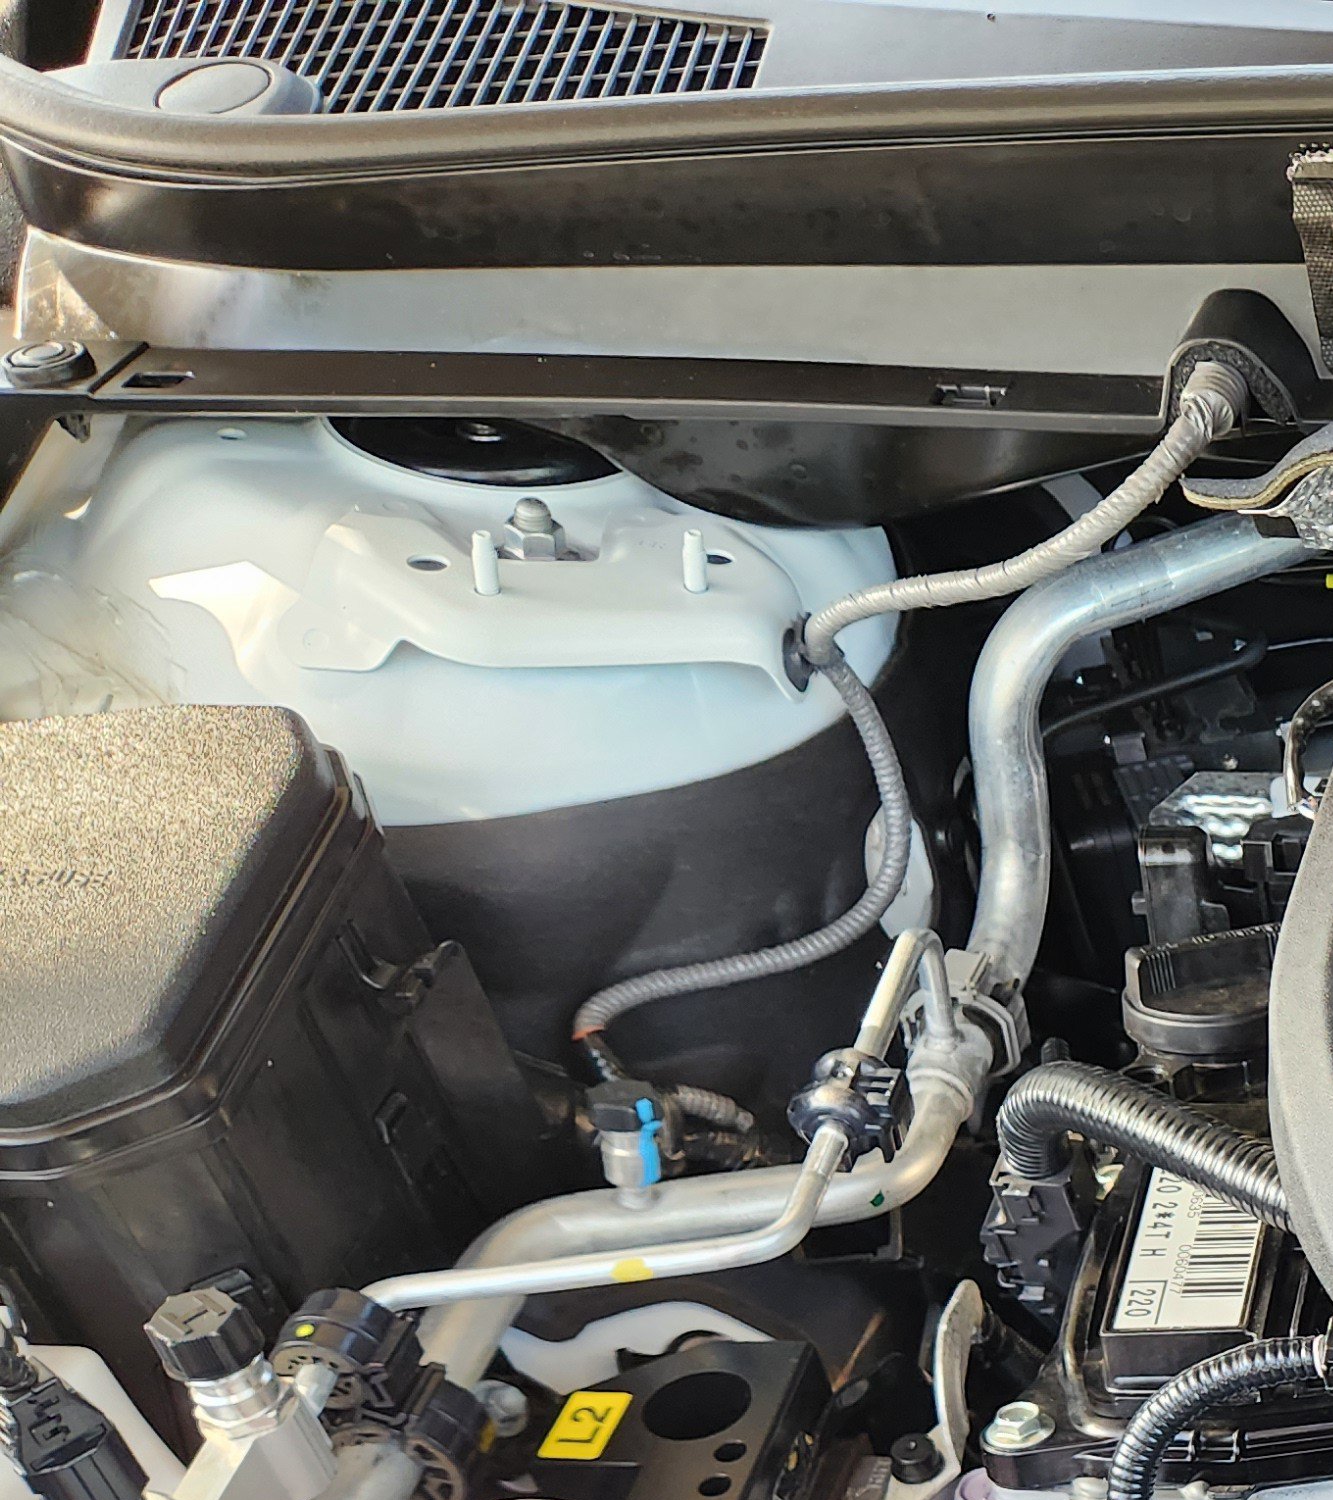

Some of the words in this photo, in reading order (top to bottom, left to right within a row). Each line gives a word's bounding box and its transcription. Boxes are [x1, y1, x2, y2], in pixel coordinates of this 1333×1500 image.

[1156, 1170, 1183, 1194] 20
[1124, 1288, 1157, 1318] 220
[556, 1406, 612, 1443] L2
